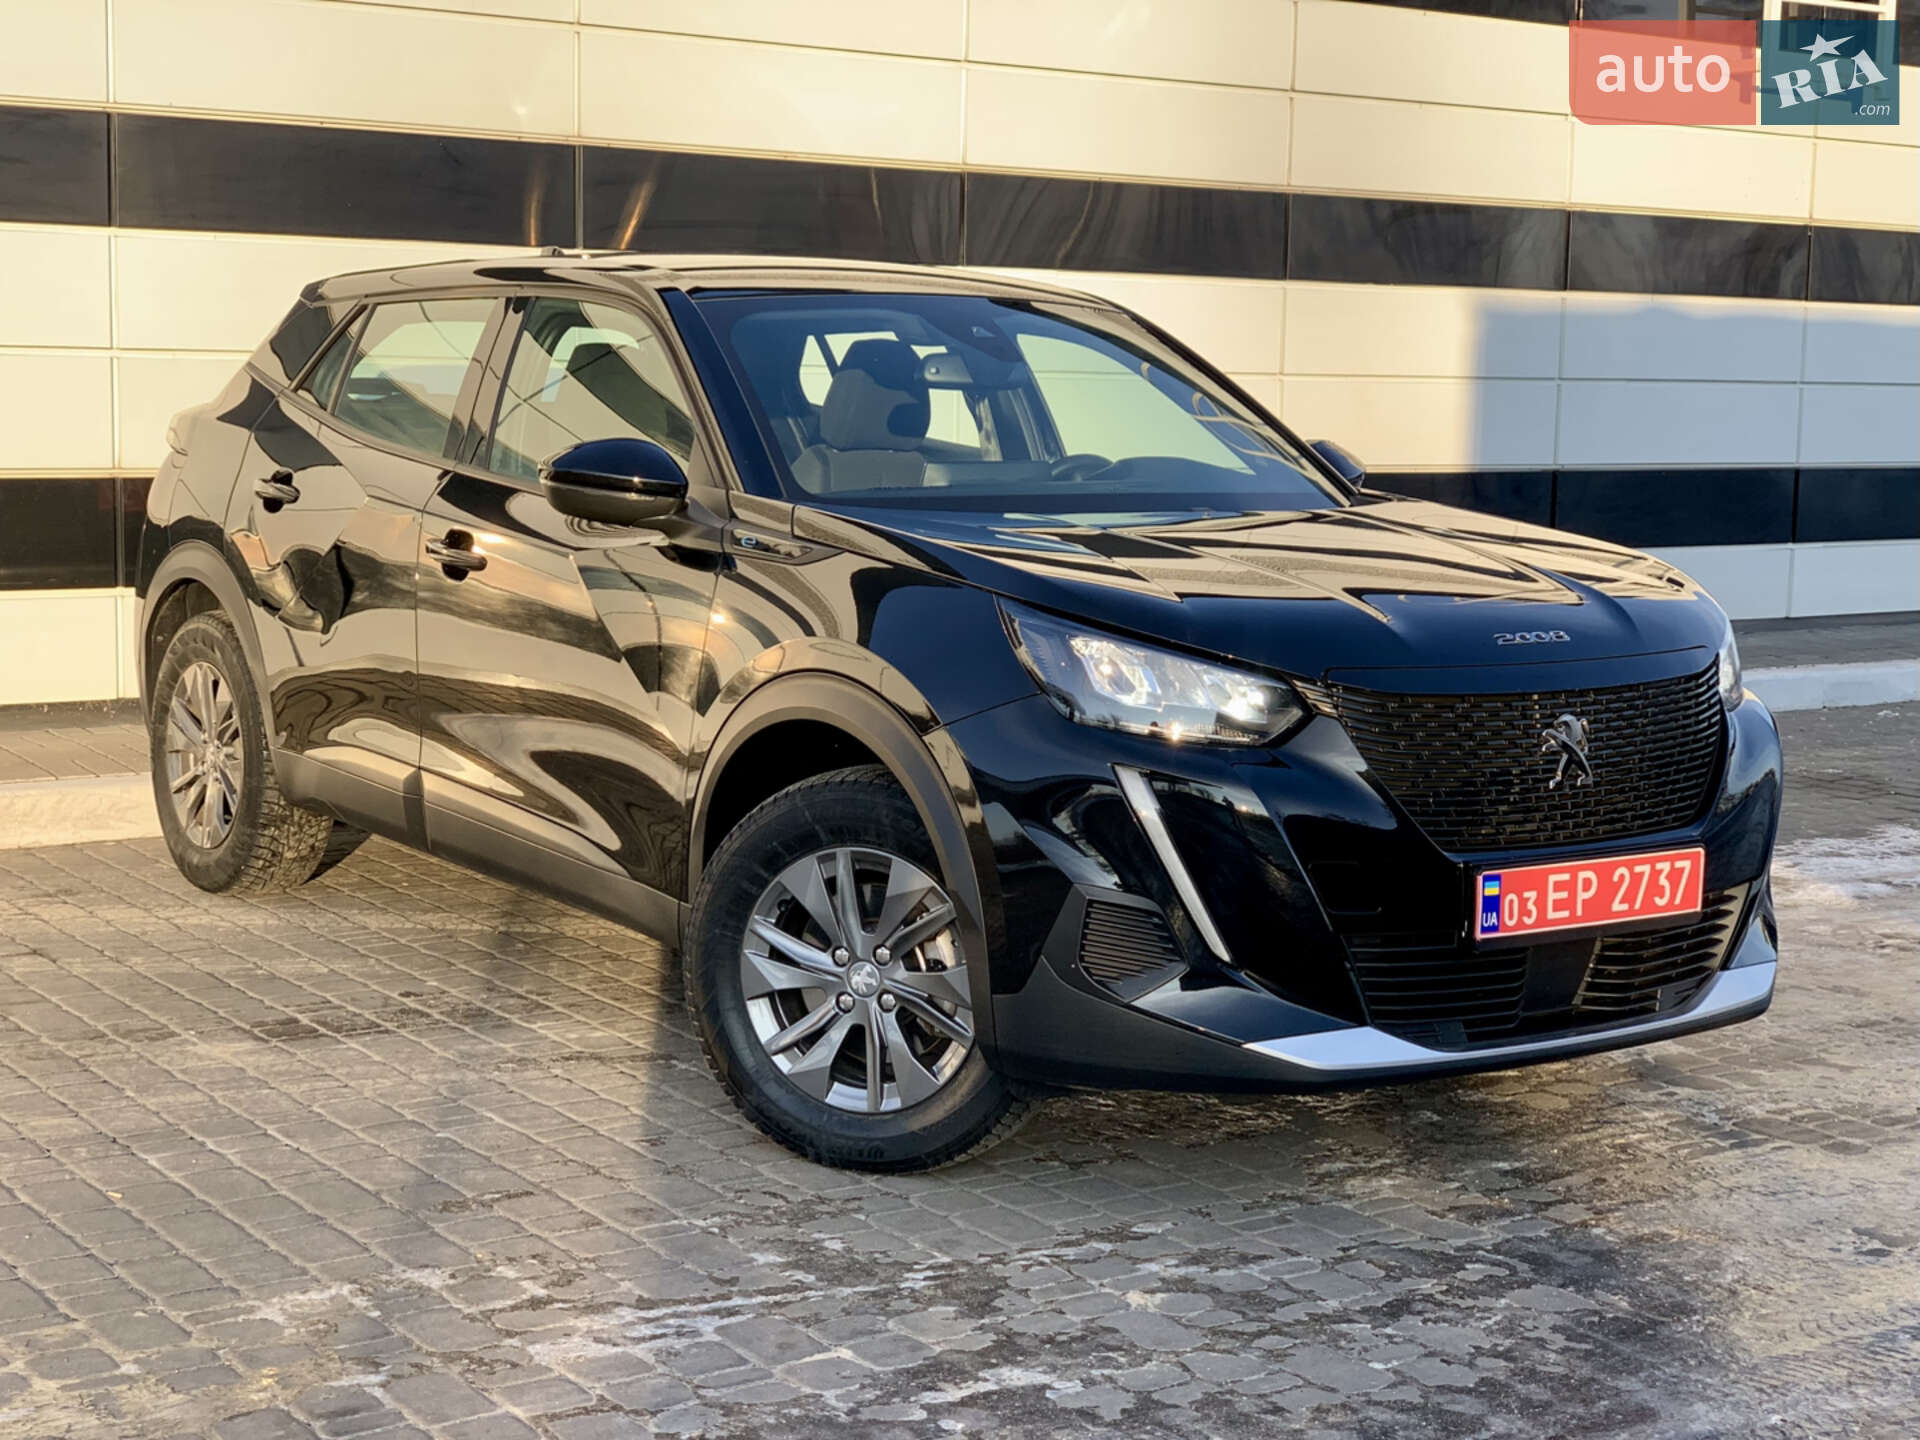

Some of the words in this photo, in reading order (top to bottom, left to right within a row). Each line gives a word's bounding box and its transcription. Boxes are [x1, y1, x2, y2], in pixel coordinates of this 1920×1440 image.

[1494, 630, 1570, 645] 2008
[1503, 890, 1537, 926] 03
[1547, 870, 1597, 920] EP
[1611, 860, 1691, 912] 2737
[1482, 911, 1498, 927] UA
